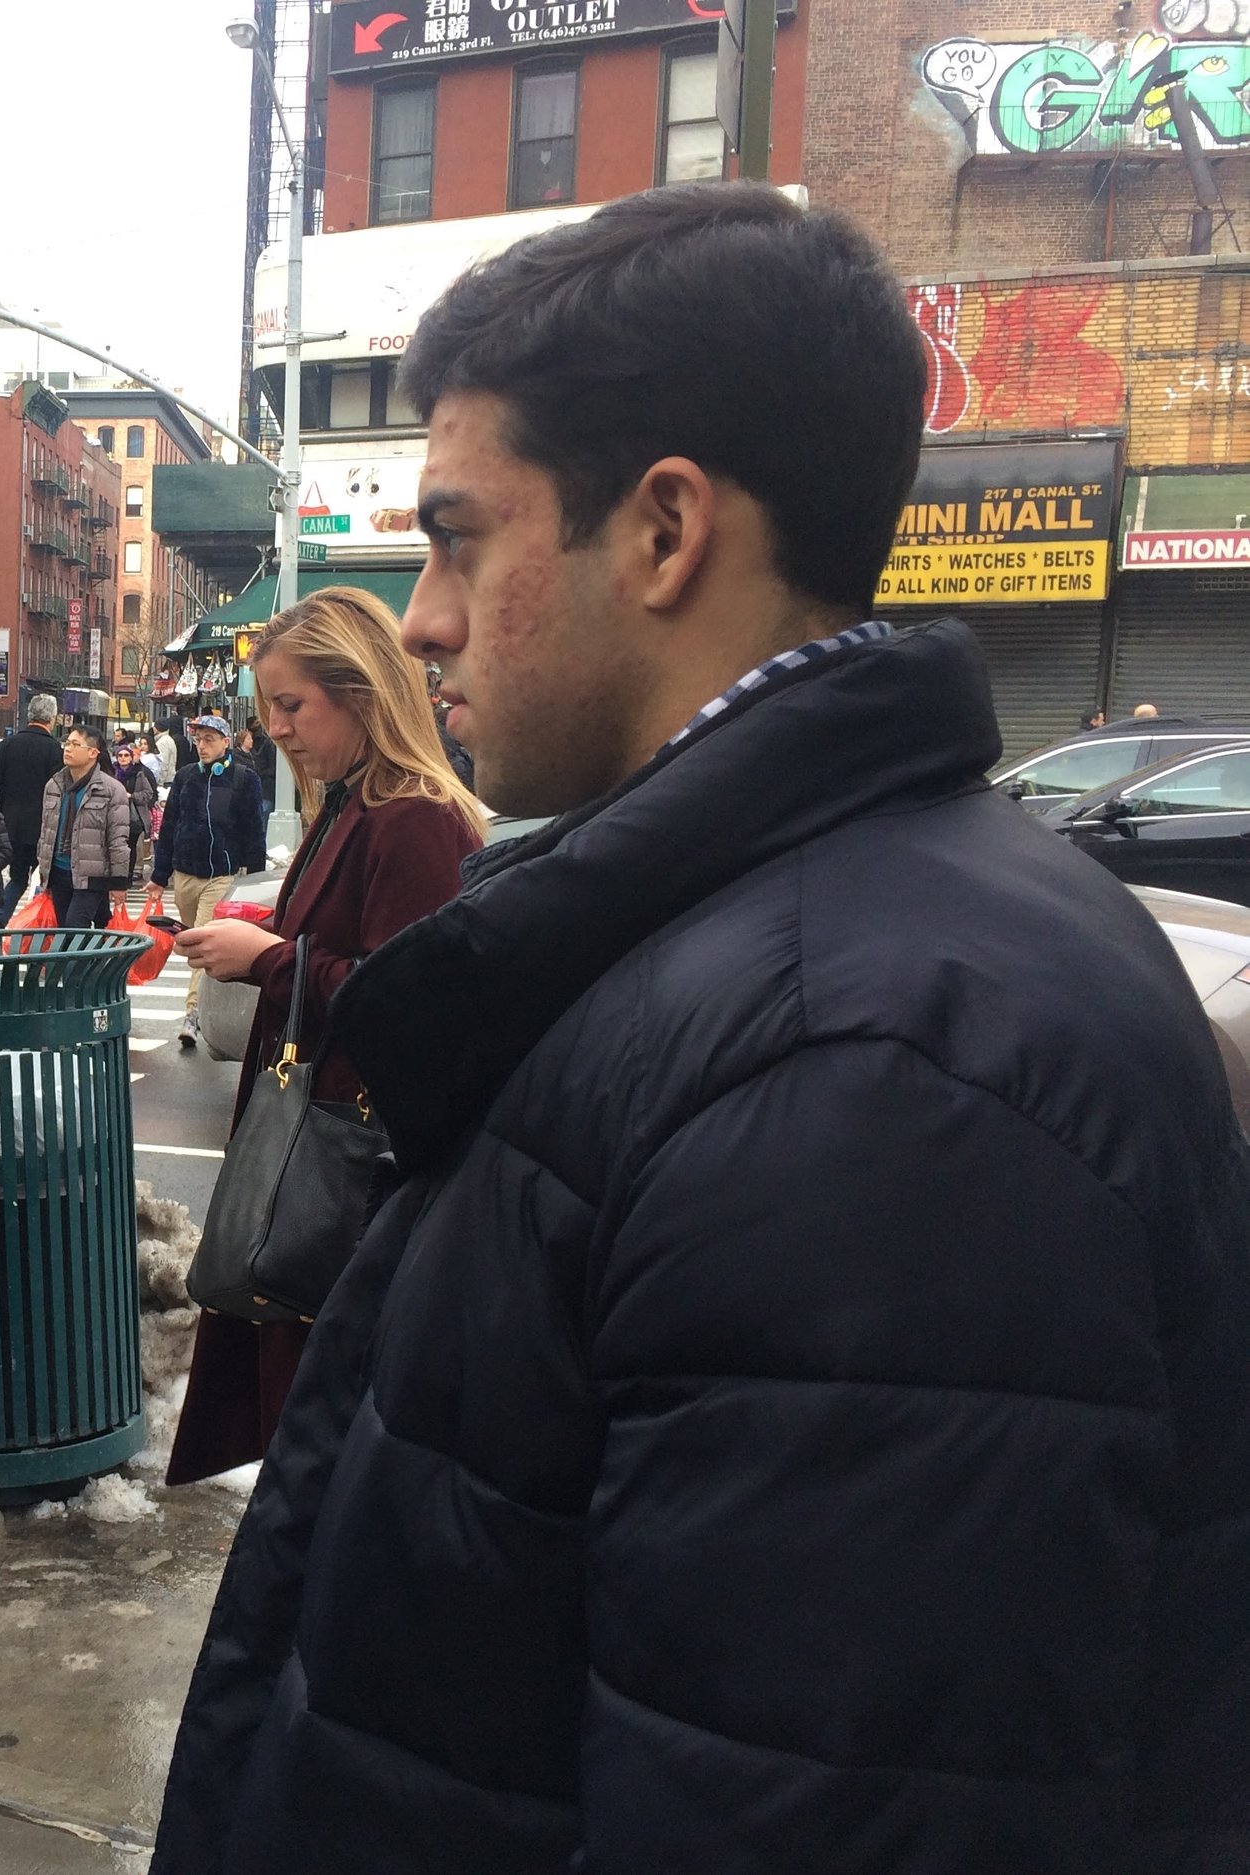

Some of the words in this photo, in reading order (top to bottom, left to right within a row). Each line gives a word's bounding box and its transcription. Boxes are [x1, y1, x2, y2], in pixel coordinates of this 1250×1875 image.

[507, 0, 620, 31] OUTLET
[511, 31, 536, 43] TEL:
[538, 24, 588, 40] (646)476
[590, 21, 617, 34] 3021
[392, 49, 410, 60] 219
[412, 42, 441, 56] Canal
[442, 42, 458, 54] St.
[459, 38, 478, 51] 3rd
[480, 36, 495, 47] Fl.
[945, 49, 987, 63] YOU
[942, 65, 974, 83] GO
[984, 488, 1007, 500] 217
[1013, 488, 1023, 499] B
[1027, 486, 1076, 498] CANAL
[1081, 485, 1103, 496] ST.
[303, 517, 338, 533] CANAL
[341, 516, 349, 525] ST
[979, 499, 1094, 532] MALL
[949, 552, 1026, 570] WATCHES
[1044, 550, 1095, 567] BELTS
[896, 577, 926, 594] ALL
[931, 576, 969, 594] KIND
[974, 576, 995, 592] OF
[1000, 575, 1037, 592] GIFT
[1042, 573, 1092, 591] ITEMS
